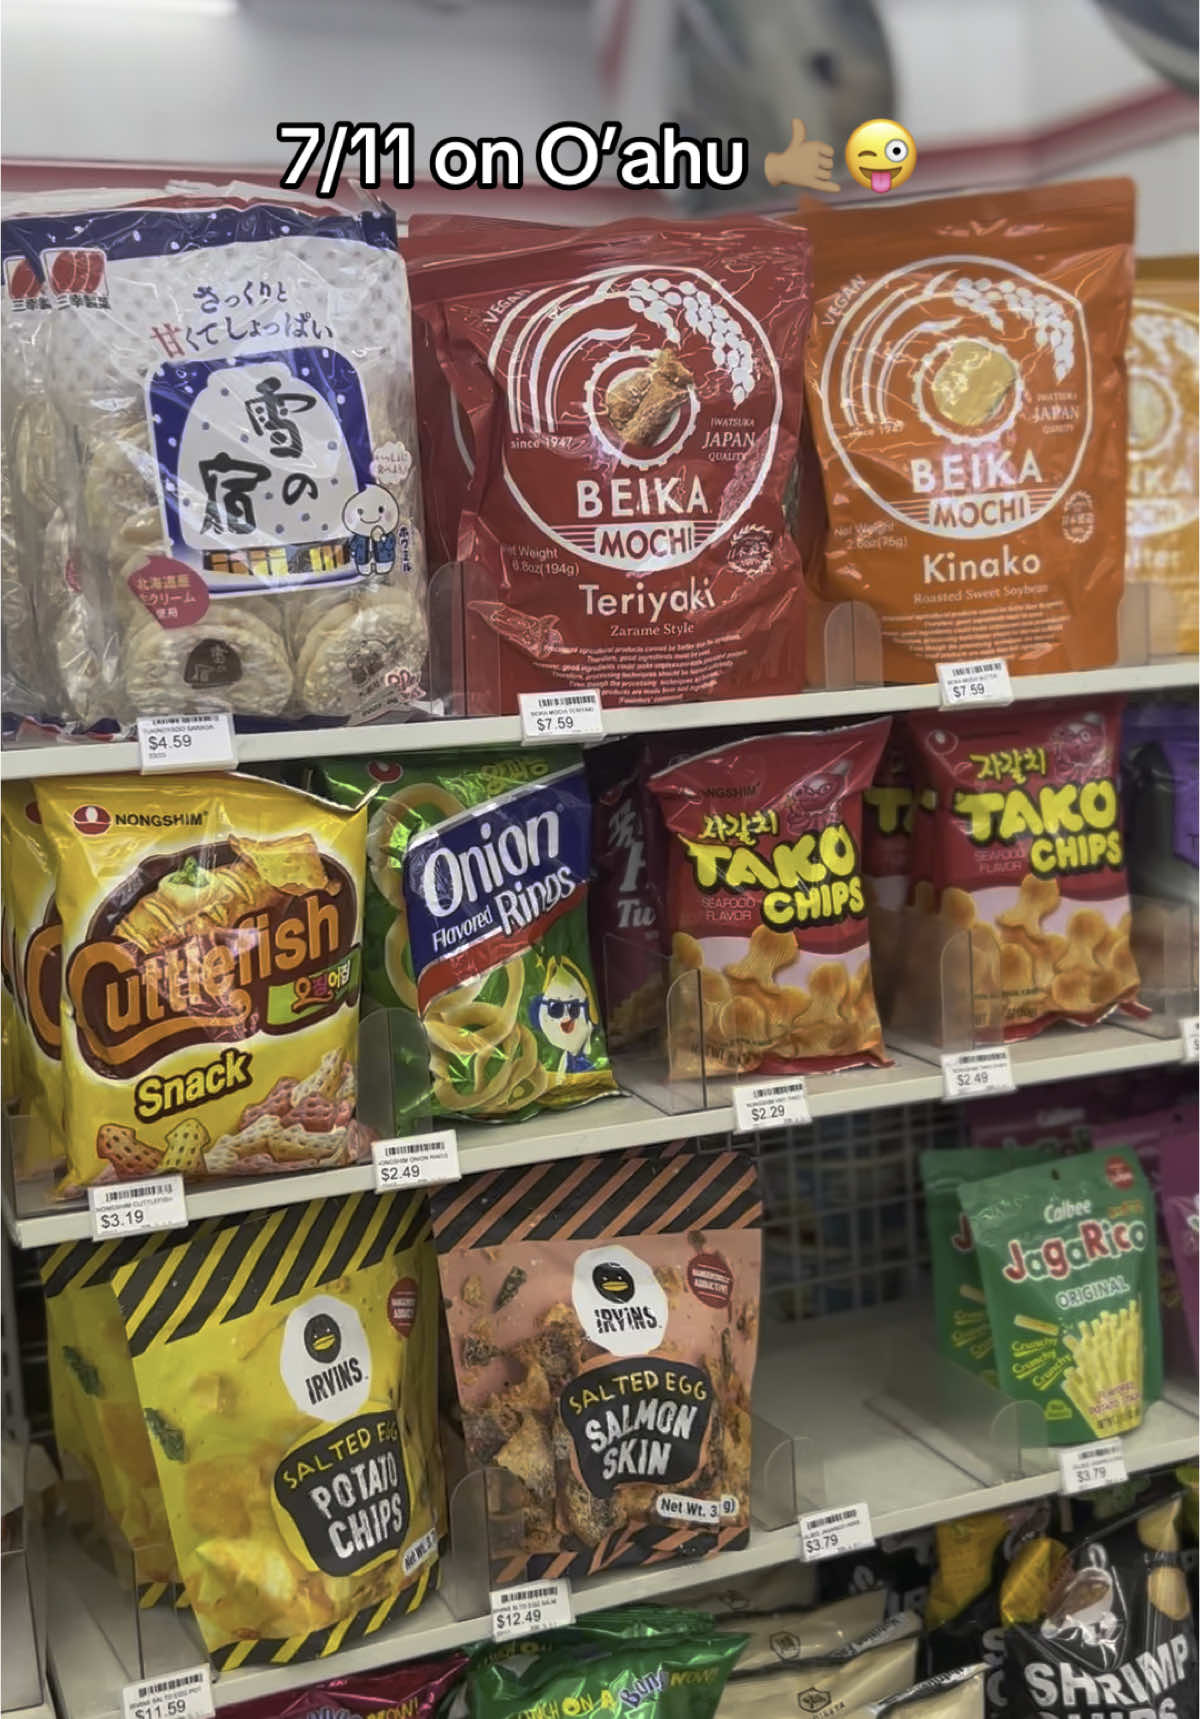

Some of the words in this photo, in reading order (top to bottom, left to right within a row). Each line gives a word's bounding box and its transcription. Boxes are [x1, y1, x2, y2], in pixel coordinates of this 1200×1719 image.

[193, 280, 288, 314] さっくりと
[483, 289, 531, 323] VEGAN
[821, 274, 868, 327] VEGAN
[151, 311, 334, 359] 甘くてしょっぱい
[1032, 405, 1080, 424] JAPAN
[510, 437, 540, 449] since
[702, 431, 756, 450] JAPAN
[708, 450, 748, 463] QUALITY
[910, 449, 1043, 493] BEIKA
[576, 476, 709, 519] BEIKA
[934, 500, 1026, 530] MOCHI
[519, 545, 558, 561] Weight
[600, 526, 693, 560] MOCHI
[923, 543, 1042, 585] Kinako
[577, 576, 716, 623] Teriyaki
[913, 588, 963, 605] Roasted
[965, 585, 1001, 601] Sweet
[610, 624, 661, 638] Zarame
[663, 622, 695, 636] Style
[952, 683, 985, 698] $7.59
[537, 716, 574, 732] $7.59
[148, 734, 193, 751] $4.59
[115, 813, 203, 827] NONGSHIM
[955, 780, 1117, 840] TAKO
[423, 810, 561, 918] Onion
[688, 823, 856, 889] TAKO
[1030, 831, 1123, 873] CHIPS
[431, 905, 493, 952] Flavored
[494, 865, 576, 936] Rings
[705, 910, 752, 921] FLAVOR
[763, 877, 865, 924] CHIPS
[68, 894, 340, 1064] Cuttlefish
[138, 1050, 250, 1122] Snack
[752, 1105, 785, 1121] $2.29
[381, 1164, 420, 1181] $2.49
[101, 1209, 144, 1229] $3.19
[1044, 1198, 1093, 1225] Calbee
[1003, 1218, 1147, 1283] JagaRico
[1056, 1275, 1131, 1310] ORIGINAL
[594, 1306, 658, 1335] IRVINS
[305, 1357, 365, 1406] IRVINS
[569, 1370, 660, 1414] SALTED
[665, 1371, 708, 1402] EGG
[585, 1399, 698, 1454] SALMON
[282, 1426, 370, 1490] SALTED
[603, 1440, 672, 1481] SKIN
[310, 1451, 399, 1520] POTATO
[661, 1497, 682, 1514] Net
[687, 1501, 706, 1518] Wt.
[328, 1493, 403, 1561] CHIPS
[806, 1533, 838, 1553] $3.79
[496, 1608, 541, 1630] $12.49
[1024, 1634, 1188, 1707] SHRIMP
[562, 1693, 594, 1717] ON
[600, 1689, 616, 1709] A
